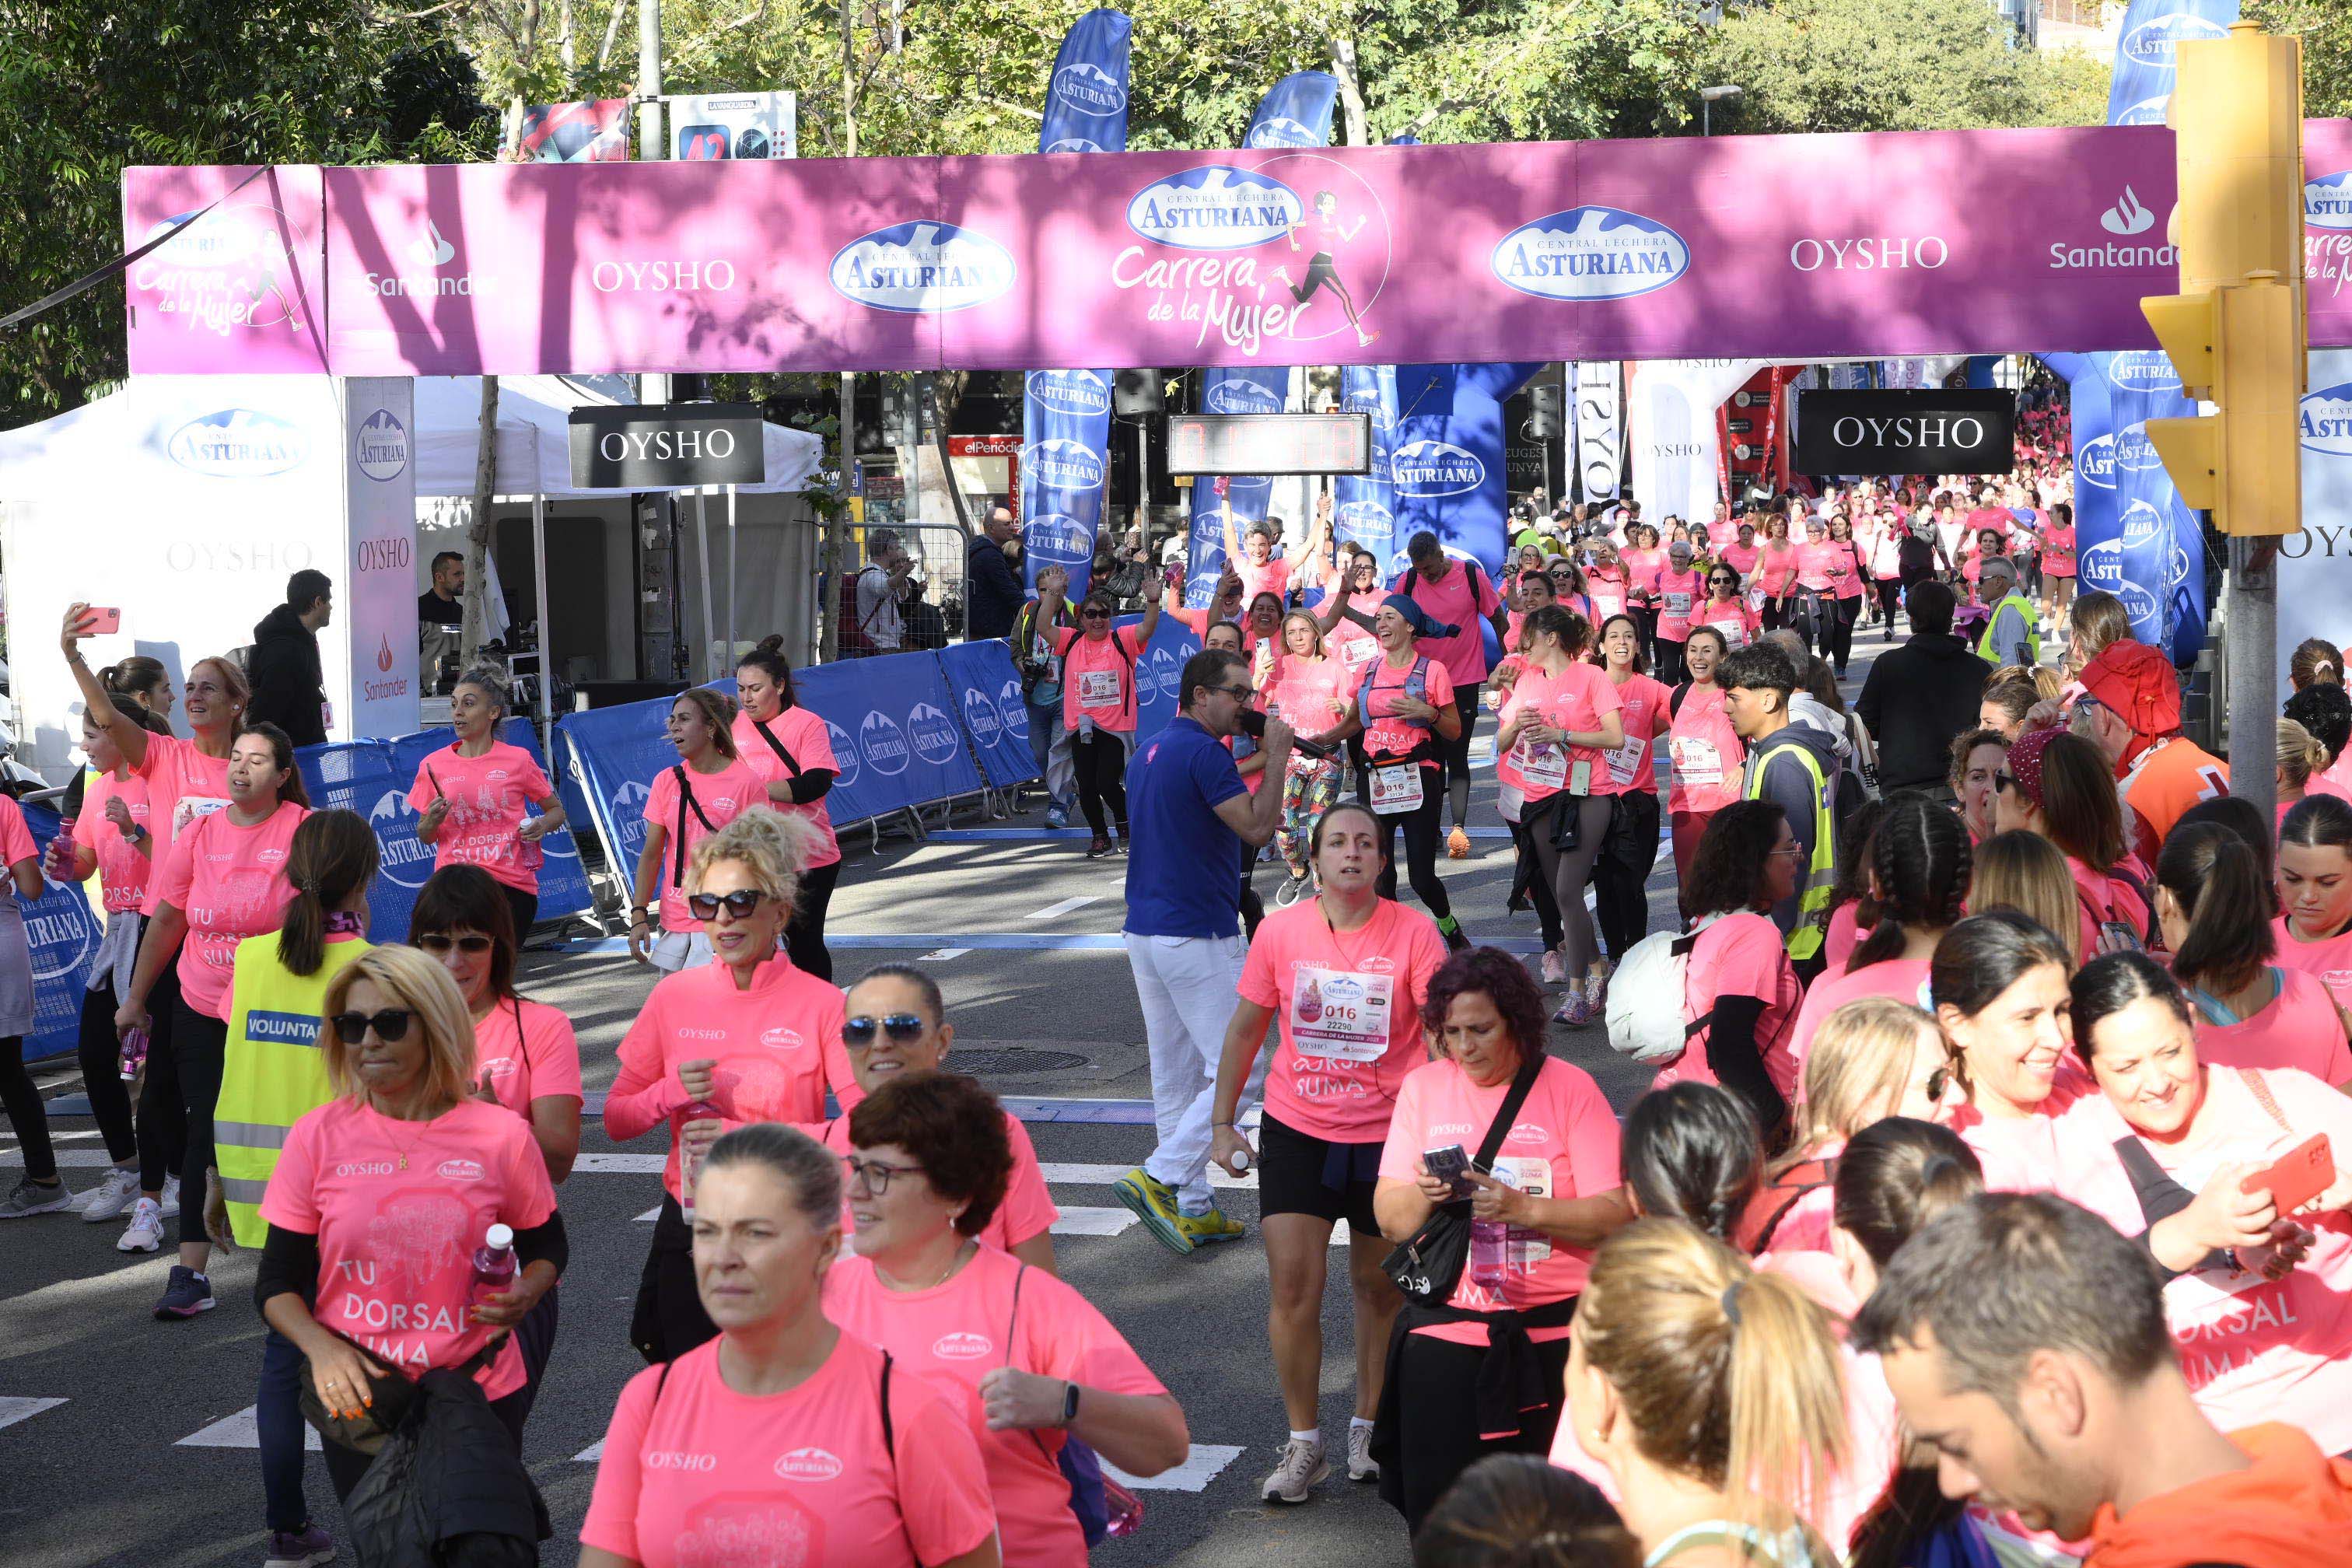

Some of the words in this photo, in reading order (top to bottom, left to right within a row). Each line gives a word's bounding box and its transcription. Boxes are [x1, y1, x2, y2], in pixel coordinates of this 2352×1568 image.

[1059, 75, 1118, 109] ASTURIANA
[1167, 194, 1222, 203] CENTRAL
[1229, 194, 1285, 203] LECHERA
[1140, 198, 1289, 229] ASTURIANA
[1538, 240, 1598, 249] CENTRAL
[1605, 237, 1668, 247] LECHERA
[1507, 243, 1675, 278] ASTURIANA
[1790, 236, 1948, 271] OYSHO
[592, 260, 735, 292] OYSHO
[844, 255, 1001, 289] ASTURIANA
[1111, 246, 1258, 289] Carrera
[2322, 257, 2336, 278] la
[1147, 292, 1174, 321] de
[1181, 291, 1199, 321] la
[1196, 284, 1312, 356] Mujer
[1034, 377, 1105, 408] ASTURIANA
[1833, 417, 1983, 449] OYSHO
[360, 436, 404, 464] ASTURIANA
[600, 429, 735, 461] OYSHO
[1643, 443, 1701, 457] YSHO
[1031, 453, 1099, 481] ASTURIANA
[1392, 464, 1477, 483] ASTURIANA
[166, 541, 313, 572] OYSHO
[358, 537, 409, 572] OYSHO
[364, 678, 408, 702] Santander
[1284, 714, 1297, 723] TU
[1294, 728, 1325, 737] ORSA
[866, 737, 908, 762] ASTURIANA
[1538, 754, 1552, 763] 016
[1605, 748, 1622, 759] 016
[1387, 783, 1405, 792] 016
[383, 823, 409, 835] CENTRAL
[469, 833, 516, 845] DORSAL
[205, 853, 233, 862] OYSHO
[452, 843, 514, 863] SUMA
[40, 896, 71, 908] LECHERA
[103, 886, 145, 903] ORSA
[194, 908, 212, 924] TU
[1291, 960, 1329, 970] OYSHO
[1362, 962, 1393, 971] ASTURIANA
[1326, 985, 1362, 996] ASTURIANA
[1325, 1005, 1356, 1020] 016
[1301, 1030, 1328, 1038] CARRERA
[1327, 1021, 1352, 1031] 22290
[679, 1027, 726, 1040] OYSHO
[765, 1035, 800, 1045] ASTURIANA
[1298, 1041, 1328, 1050] OYSHO
[1349, 1046, 1379, 1055] Santander
[1296, 1077, 1364, 1096] SUMA
[1430, 1123, 1472, 1136] OYSHO
[1510, 1132, 1546, 1141] ASTURIANA
[337, 1162, 393, 1176] OYSHO
[440, 1166, 481, 1178] ASTURIANA
[337, 1260, 375, 1285] TU
[1463, 1285, 1508, 1304] MA
[344, 1293, 469, 1333] DORSAL
[937, 1342, 989, 1355] ASTURIANA
[648, 1451, 716, 1472] OYSHO
[780, 1459, 839, 1475] ASTURIANA
